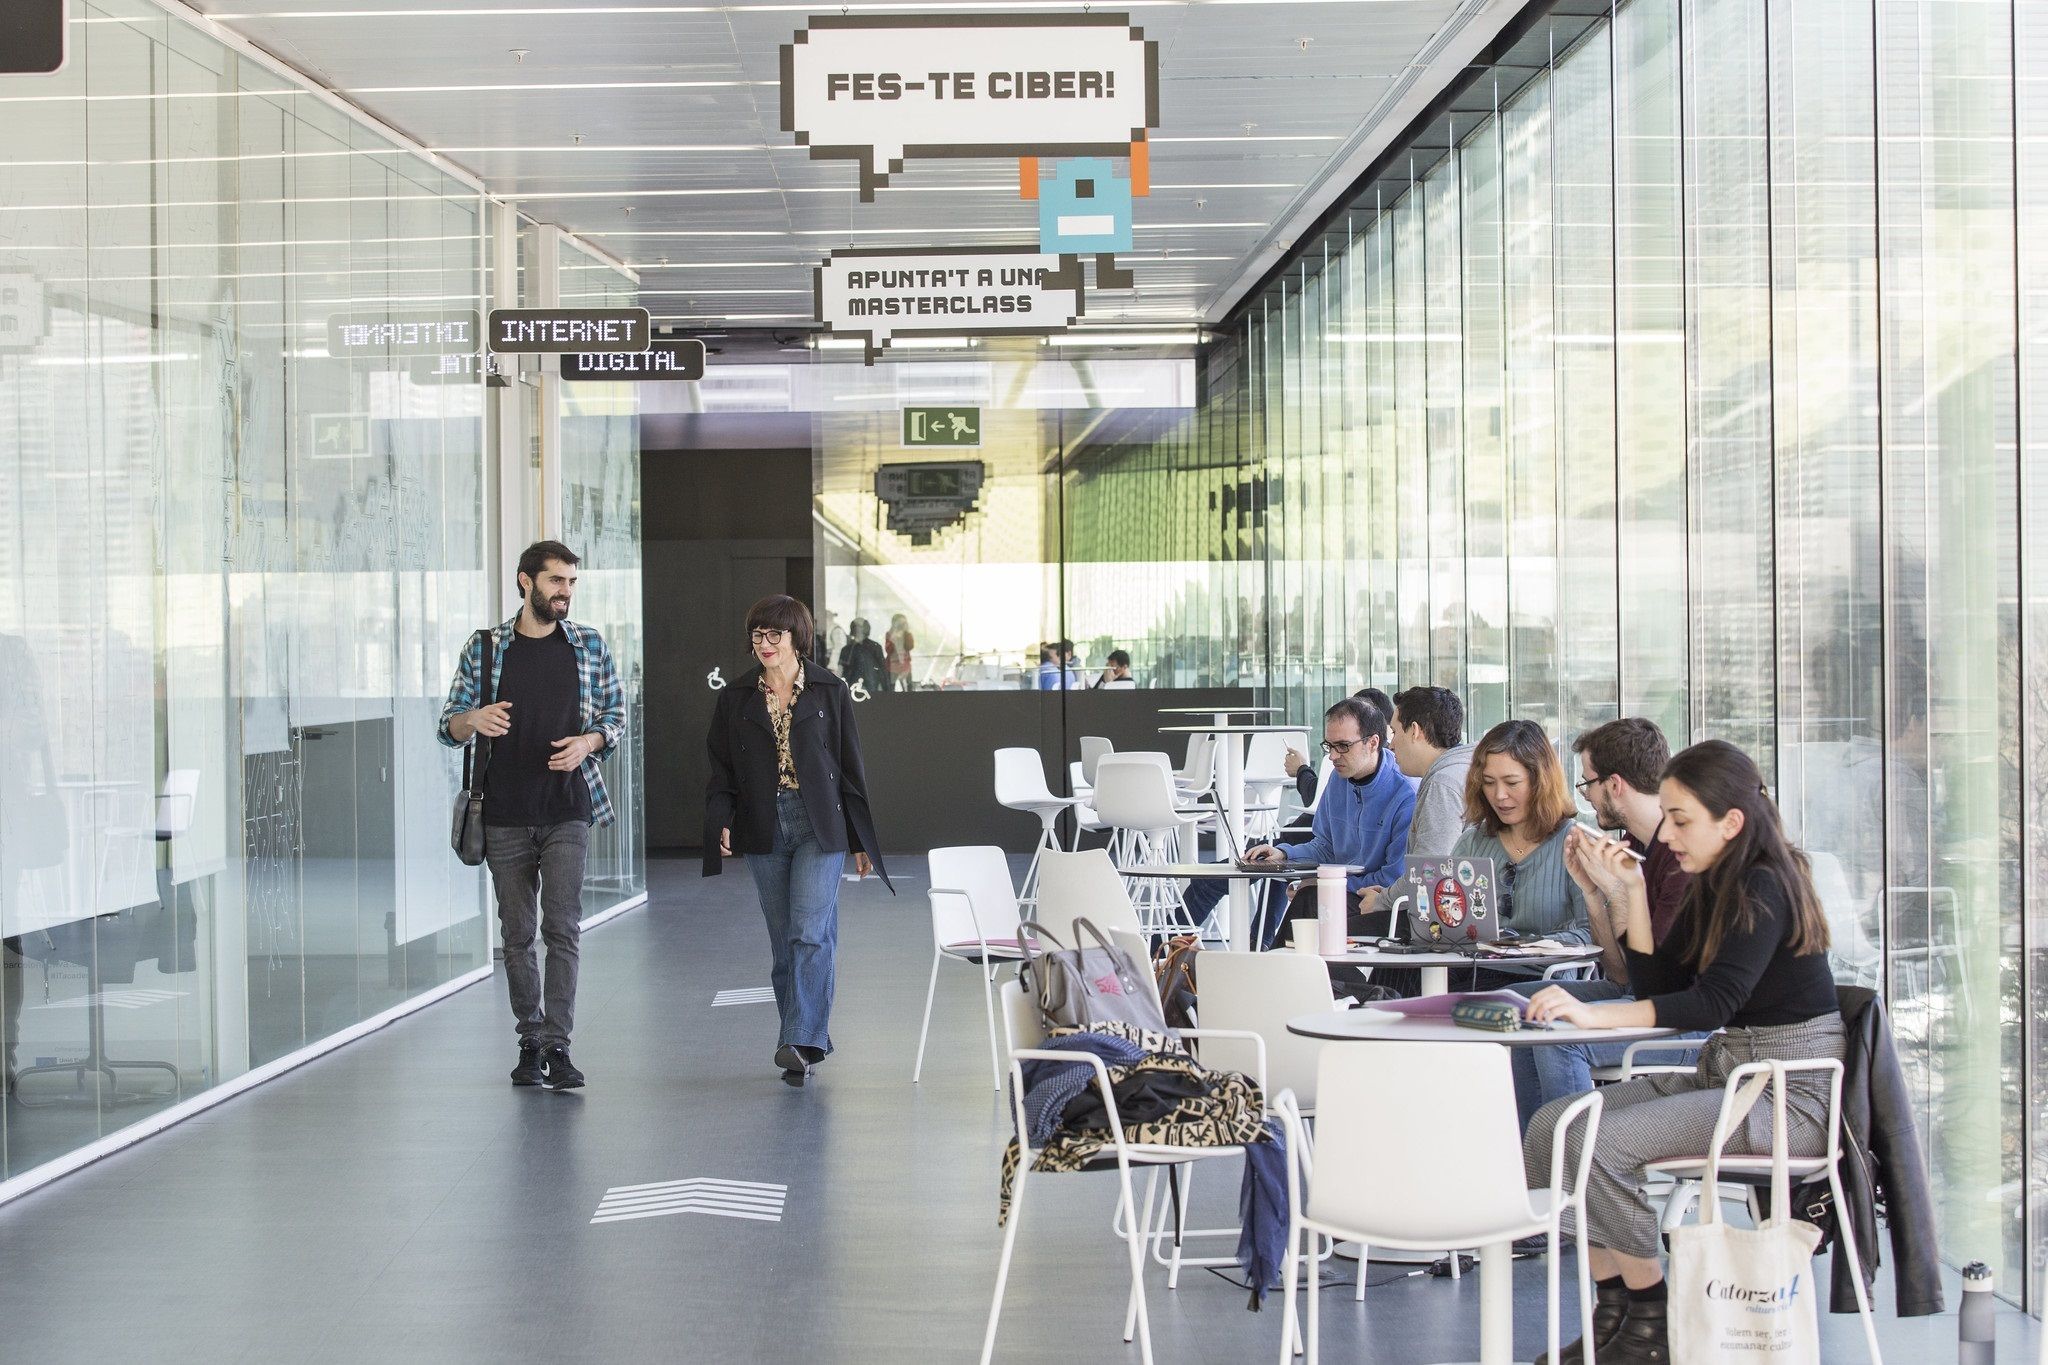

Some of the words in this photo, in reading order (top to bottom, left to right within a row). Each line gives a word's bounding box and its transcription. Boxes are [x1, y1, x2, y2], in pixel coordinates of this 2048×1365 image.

[827, 72, 975, 100] FES-TE
[988, 70, 1115, 99] CIBER!
[847, 269, 970, 289] APUNTA'T
[977, 268, 993, 287] A
[848, 294, 1032, 316] MASTERCLASS
[501, 319, 638, 342] INTERNET
[578, 351, 686, 371] DIGITAL
